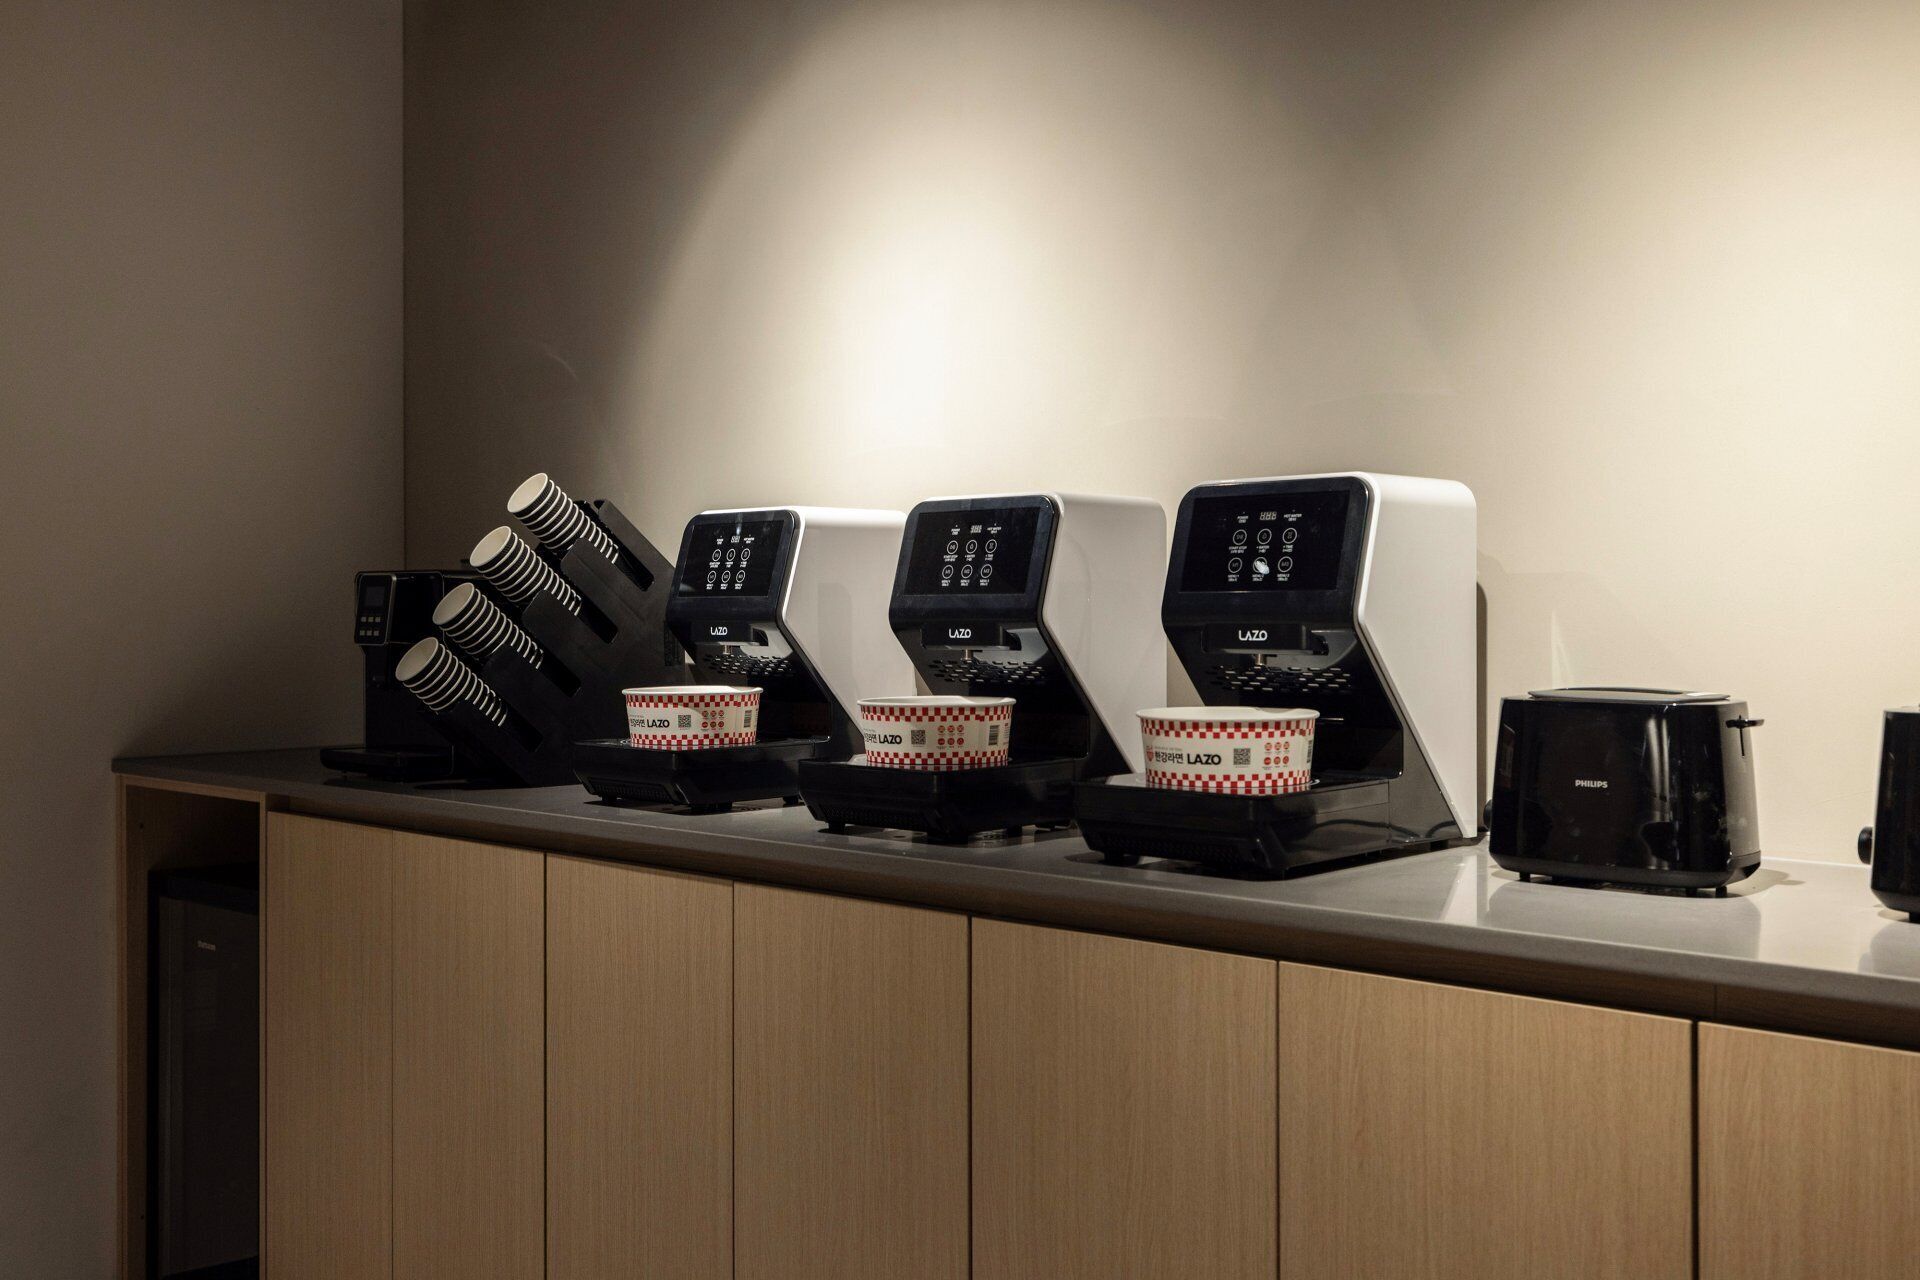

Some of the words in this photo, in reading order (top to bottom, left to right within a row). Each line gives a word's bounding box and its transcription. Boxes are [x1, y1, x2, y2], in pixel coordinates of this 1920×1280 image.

[710, 626, 728, 636] LAZO
[948, 628, 972, 639] LAZO
[1238, 629, 1268, 641] LAZO
[646, 718, 670, 728] LAZO
[878, 734, 903, 744] LAZO
[1155, 750, 1183, 764] 한강라면
[1187, 753, 1222, 766] LAZO
[1575, 779, 1608, 789] PHILIPS
